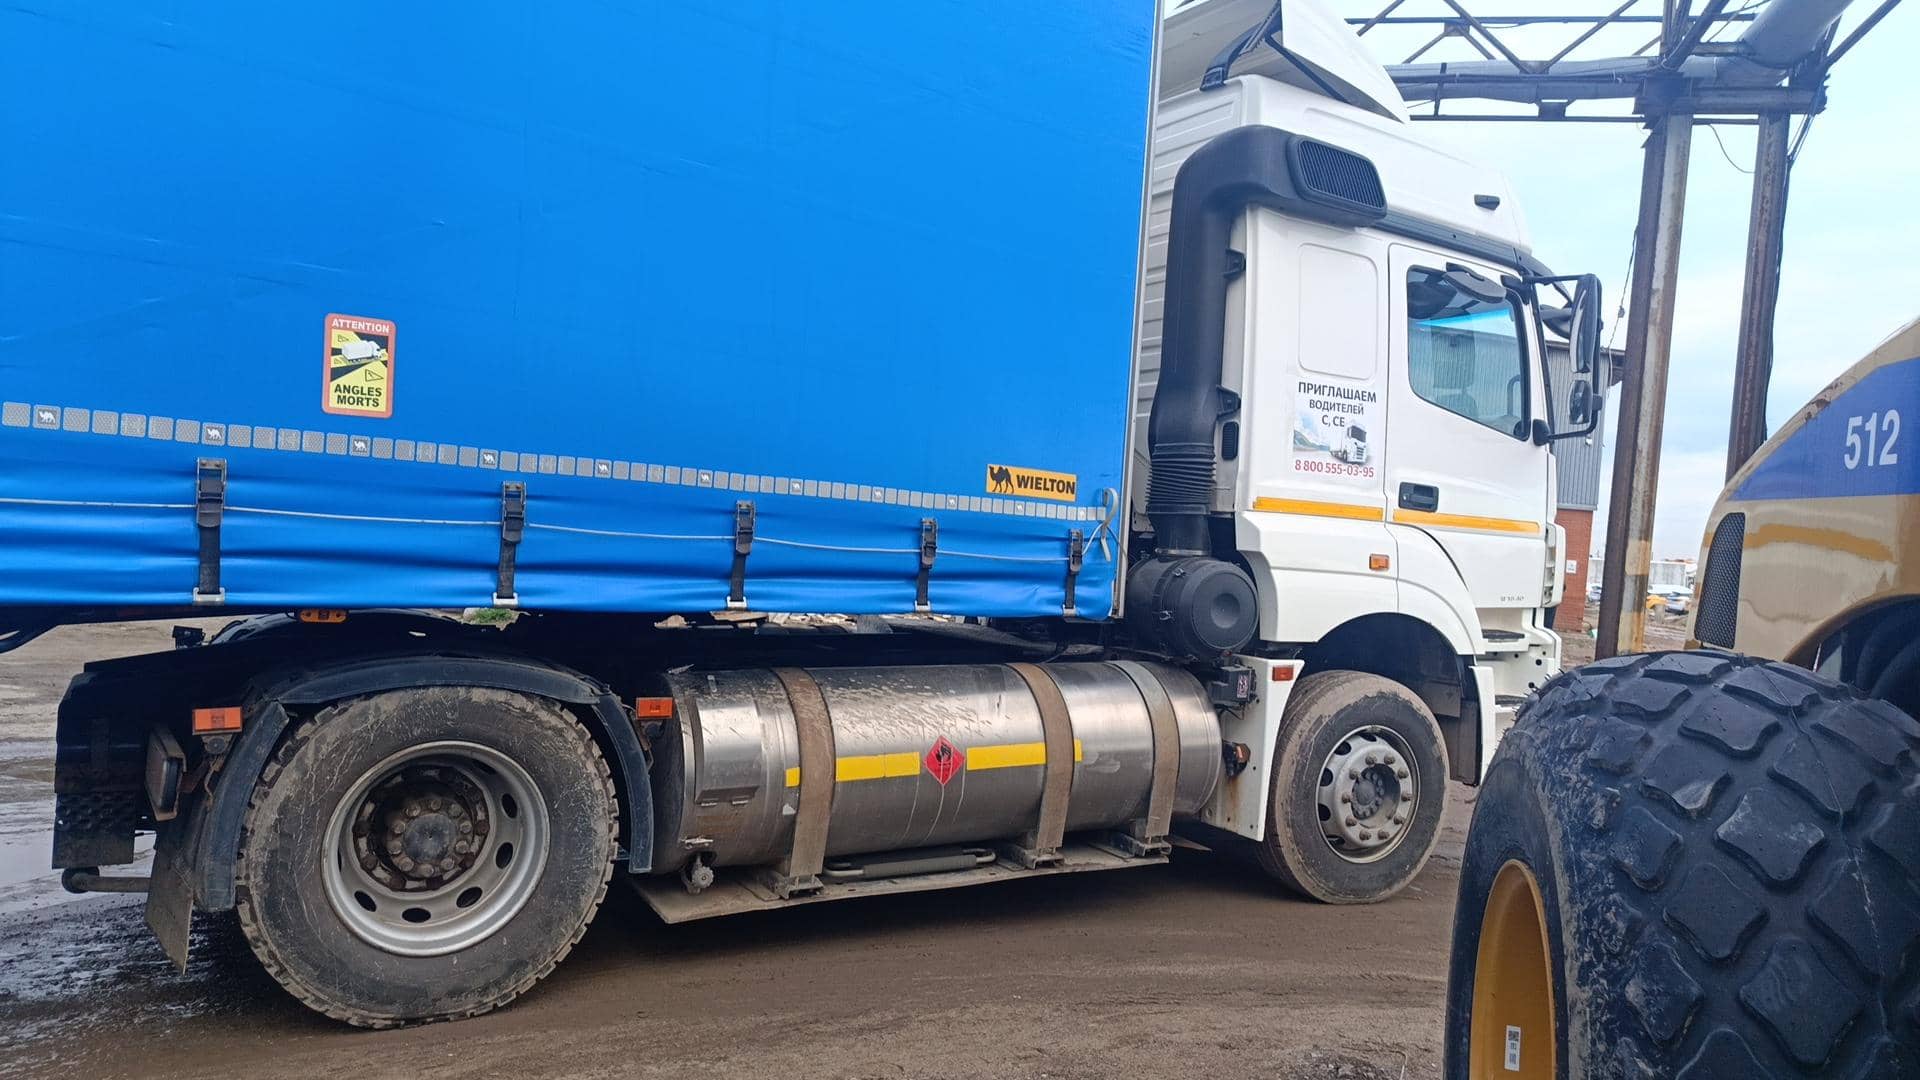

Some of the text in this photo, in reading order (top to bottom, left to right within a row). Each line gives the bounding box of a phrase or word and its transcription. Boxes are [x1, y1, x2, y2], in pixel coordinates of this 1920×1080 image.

[332, 318, 389, 333] ATTENTION
[334, 384, 382, 397] ANGLES
[1298, 381, 1377, 403] ПРИГЛАШАЕМ
[336, 395, 380, 408] MORTS
[1309, 399, 1364, 415] ВОДИТЕЛЕЙ
[1844, 409, 1901, 470] 512
[1294, 459, 1375, 478] 8 800 555-03-95
[1016, 474, 1076, 495] WIELTON
